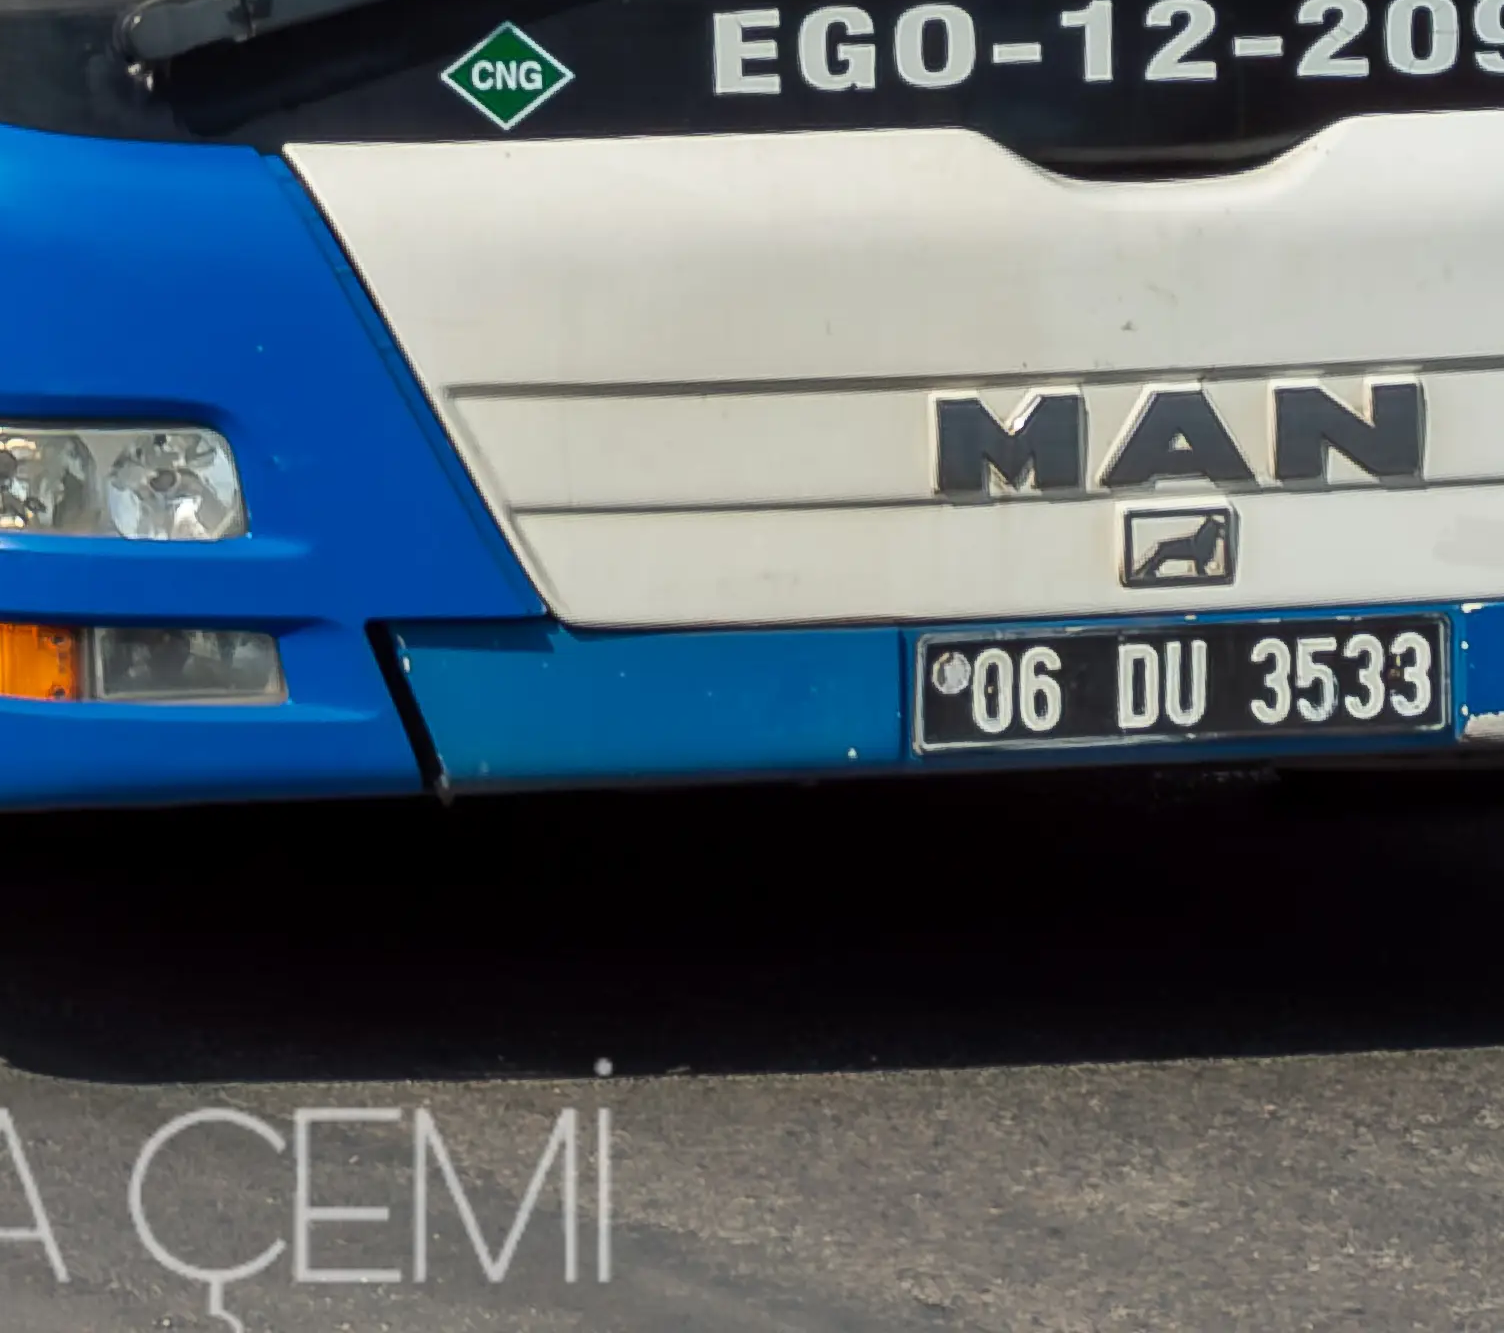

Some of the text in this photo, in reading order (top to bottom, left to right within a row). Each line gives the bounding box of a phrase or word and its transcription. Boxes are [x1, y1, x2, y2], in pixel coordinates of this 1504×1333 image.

[471, 59, 543, 91] CNG
[935, 382, 1425, 494] MAN
[971, 648, 1063, 736] 06
[1251, 633, 1433, 725] 3533
